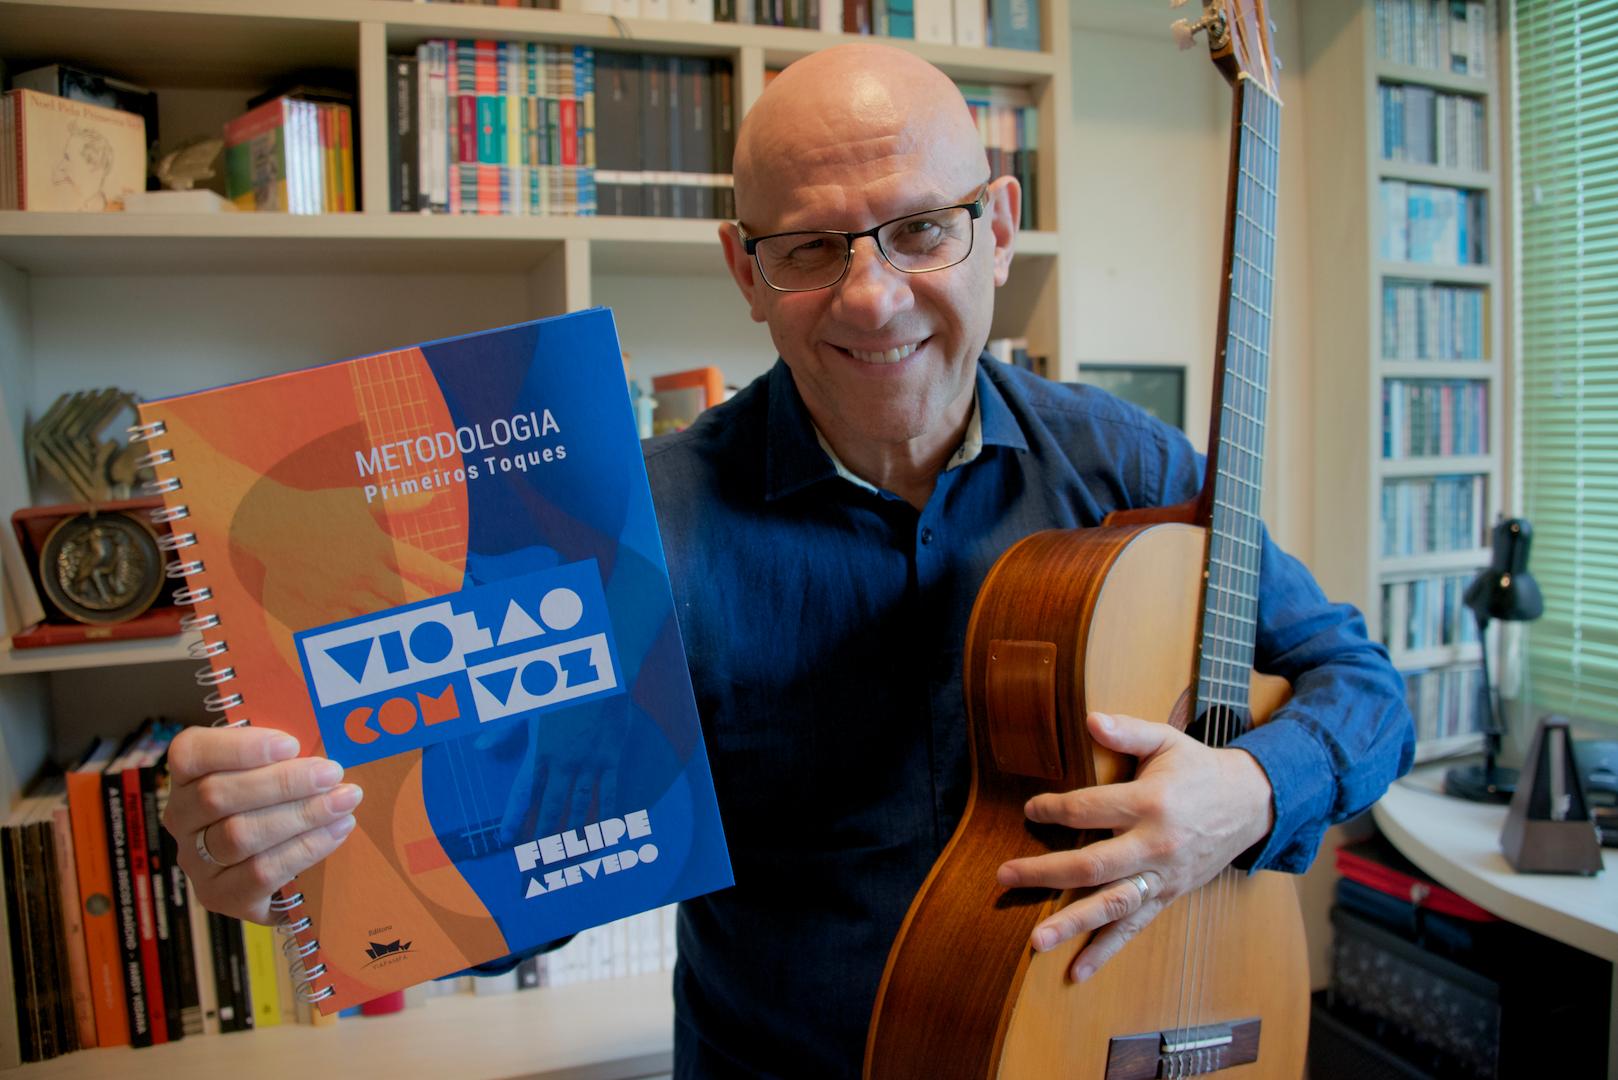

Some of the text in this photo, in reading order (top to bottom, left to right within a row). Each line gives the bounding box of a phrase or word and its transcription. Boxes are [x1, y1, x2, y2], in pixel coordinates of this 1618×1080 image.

[355, 408, 561, 478] METODOLOGIA
[364, 444, 567, 503] Primeiros Toques
[344, 647, 600, 745] COM VOZ
[513, 808, 652, 873] FELIPE
[524, 843, 659, 900] AZEVEDO
